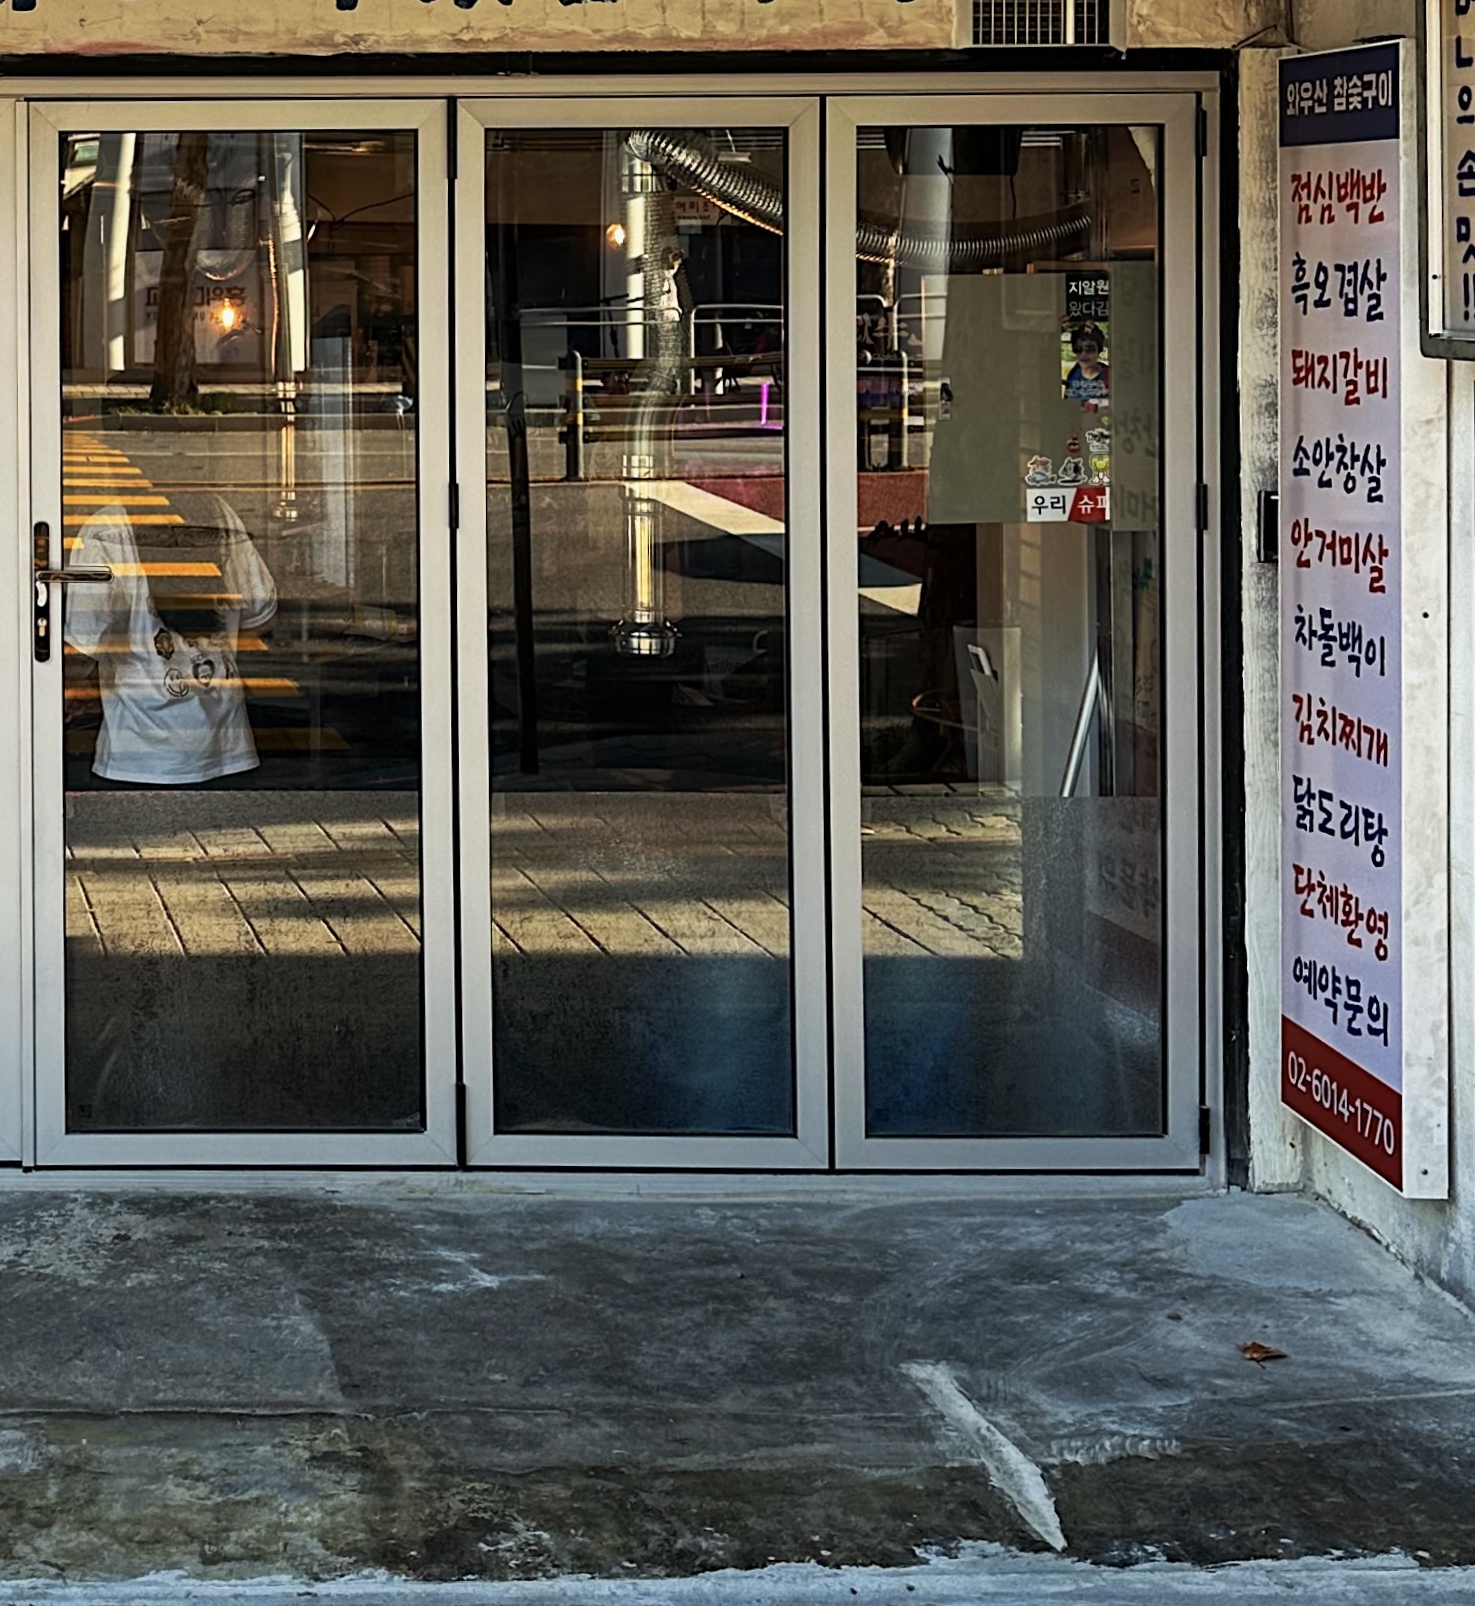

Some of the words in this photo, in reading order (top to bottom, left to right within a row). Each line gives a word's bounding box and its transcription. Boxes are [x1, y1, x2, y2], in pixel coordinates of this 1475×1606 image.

[1286, 78, 1328, 116] 와우산
[1290, 168, 1387, 225] 점심백반
[1290, 347, 1388, 406] 돼지갈비
[1291, 433, 1387, 503] 소안창살
[1290, 517, 1389, 594] 안거미살
[1293, 604, 1386, 678] 차돌백이
[1292, 693, 1388, 767] 김치찌개
[1292, 774, 1388, 868] 닭도리탕
[1292, 863, 1389, 962] 단체환영
[1292, 956, 1389, 1047] 예약문의
[1287, 1051, 1395, 1155] 02-6014-1770
